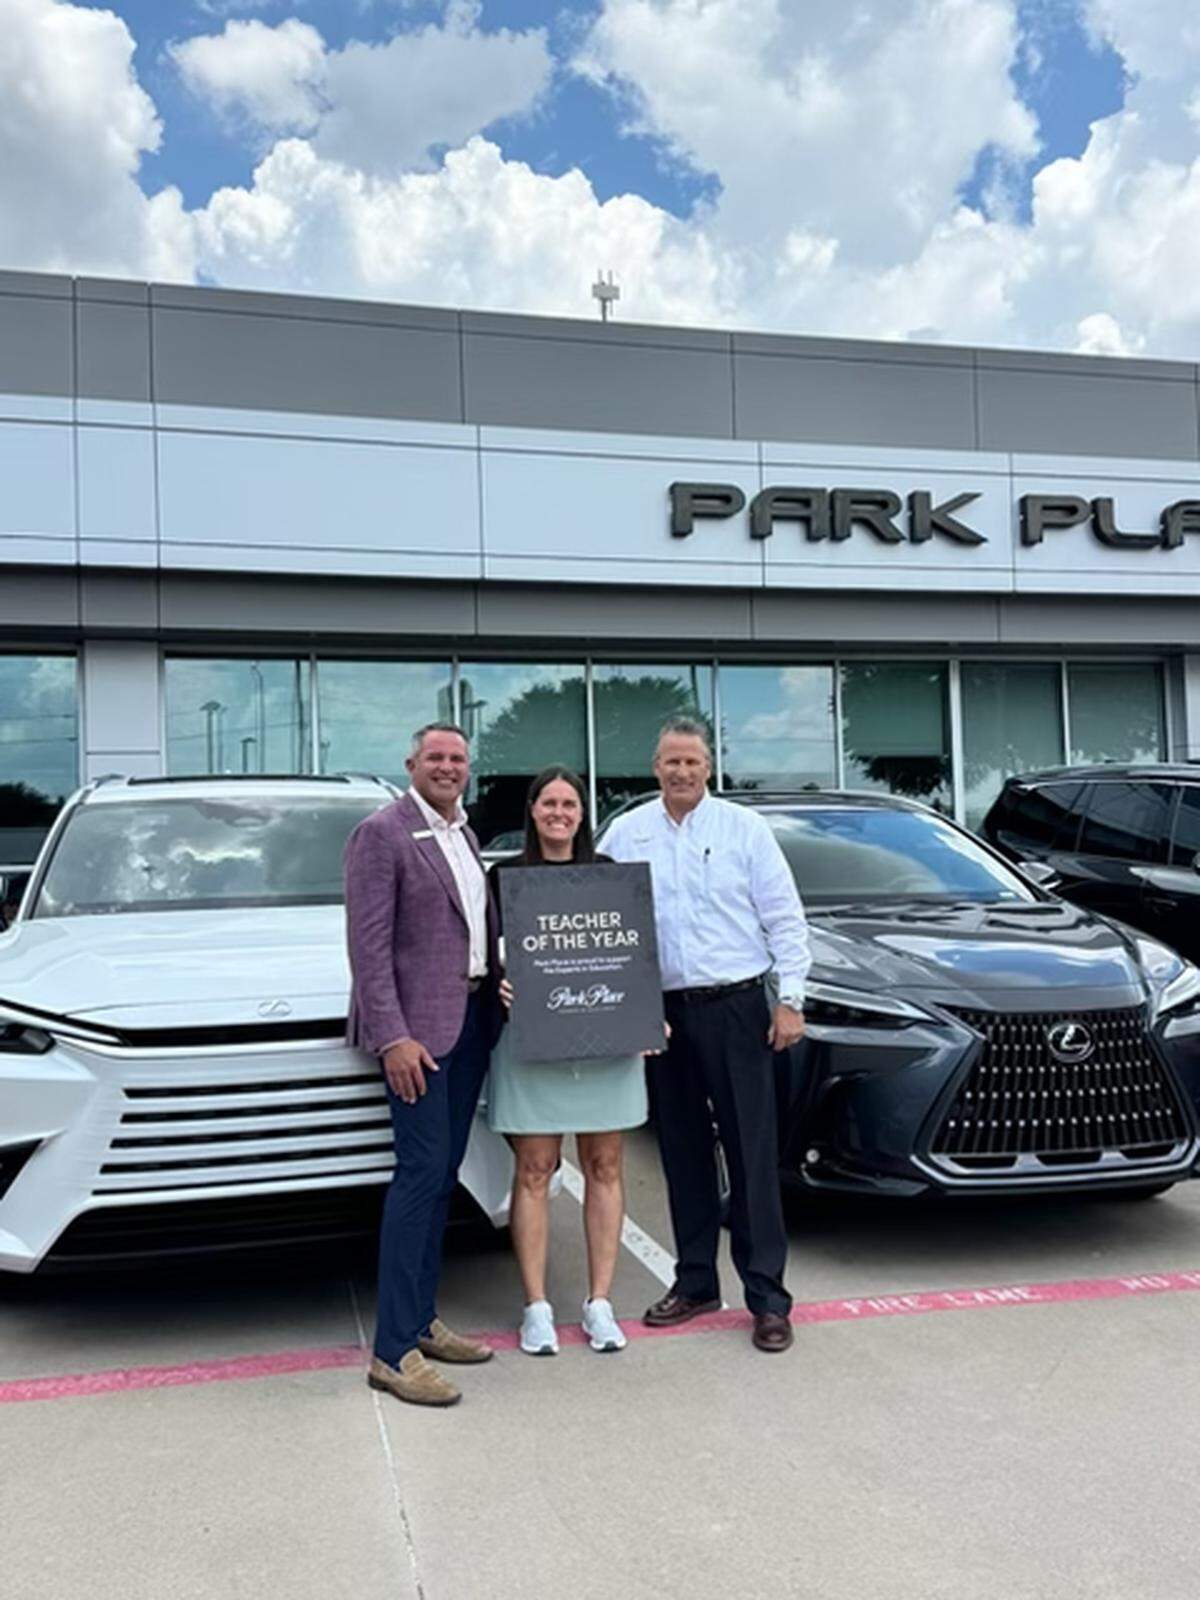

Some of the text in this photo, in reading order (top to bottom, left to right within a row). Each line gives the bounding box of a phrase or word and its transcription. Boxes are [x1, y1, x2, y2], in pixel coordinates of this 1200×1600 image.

[669, 481, 989, 545] PARK
[537, 911, 621, 931] TEACHER
[522, 929, 639, 952] OF THE YEAR
[546, 985, 587, 1010] Park
[842, 1294, 932, 1314] FIRE
[942, 1286, 1042, 1306] LANE
[1119, 1275, 1171, 1291] NO
